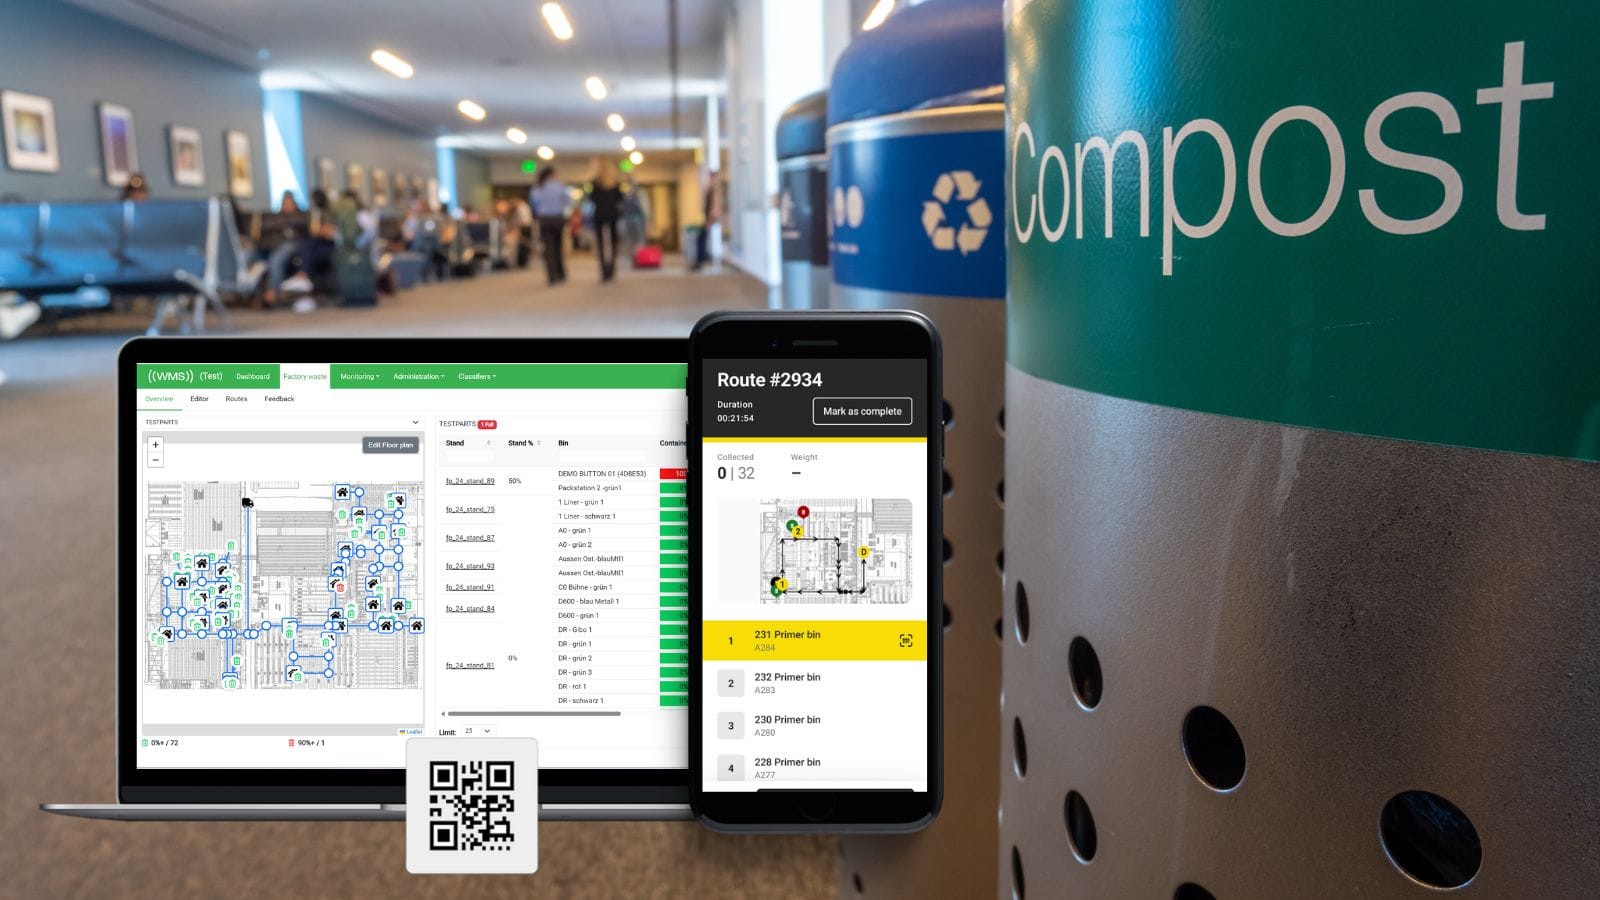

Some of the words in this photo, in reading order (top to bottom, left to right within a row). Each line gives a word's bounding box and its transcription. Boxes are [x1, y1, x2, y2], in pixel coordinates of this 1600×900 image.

[1012, 41, 1554, 276] Compost
[200, 372, 222, 381] (Test)
[283, 373, 307, 381] Factory
[718, 372, 766, 387] Route
[770, 372, 823, 387] #2934
[824, 407, 846, 415] Mark
[861, 407, 902, 417] complete
[717, 453, 754, 461] Collected
[791, 454, 818, 462] Weight
[718, 466, 726, 479] 0
[738, 467, 754, 479] 32
[795, 527, 801, 535] 2
[861, 548, 867, 556] D
[755, 630, 771, 639] 231
[774, 630, 805, 639] Primer
[806, 630, 821, 639] bin
[729, 636, 733, 645] 1
[754, 644, 776, 652] A284
[755, 673, 772, 681] 232
[775, 672, 805, 681] Primer
[807, 673, 821, 681] bin
[728, 679, 734, 687] 2
[754, 686, 776, 694] A283
[755, 715, 772, 724] 230
[775, 715, 805, 724] Primer
[807, 715, 820, 724] bin
[728, 722, 734, 730] 3
[754, 728, 776, 737] A280
[755, 758, 772, 766] 228
[775, 758, 805, 766] Primer
[807, 758, 821, 766] bin
[728, 764, 734, 772] 4
[754, 771, 776, 779] A277
